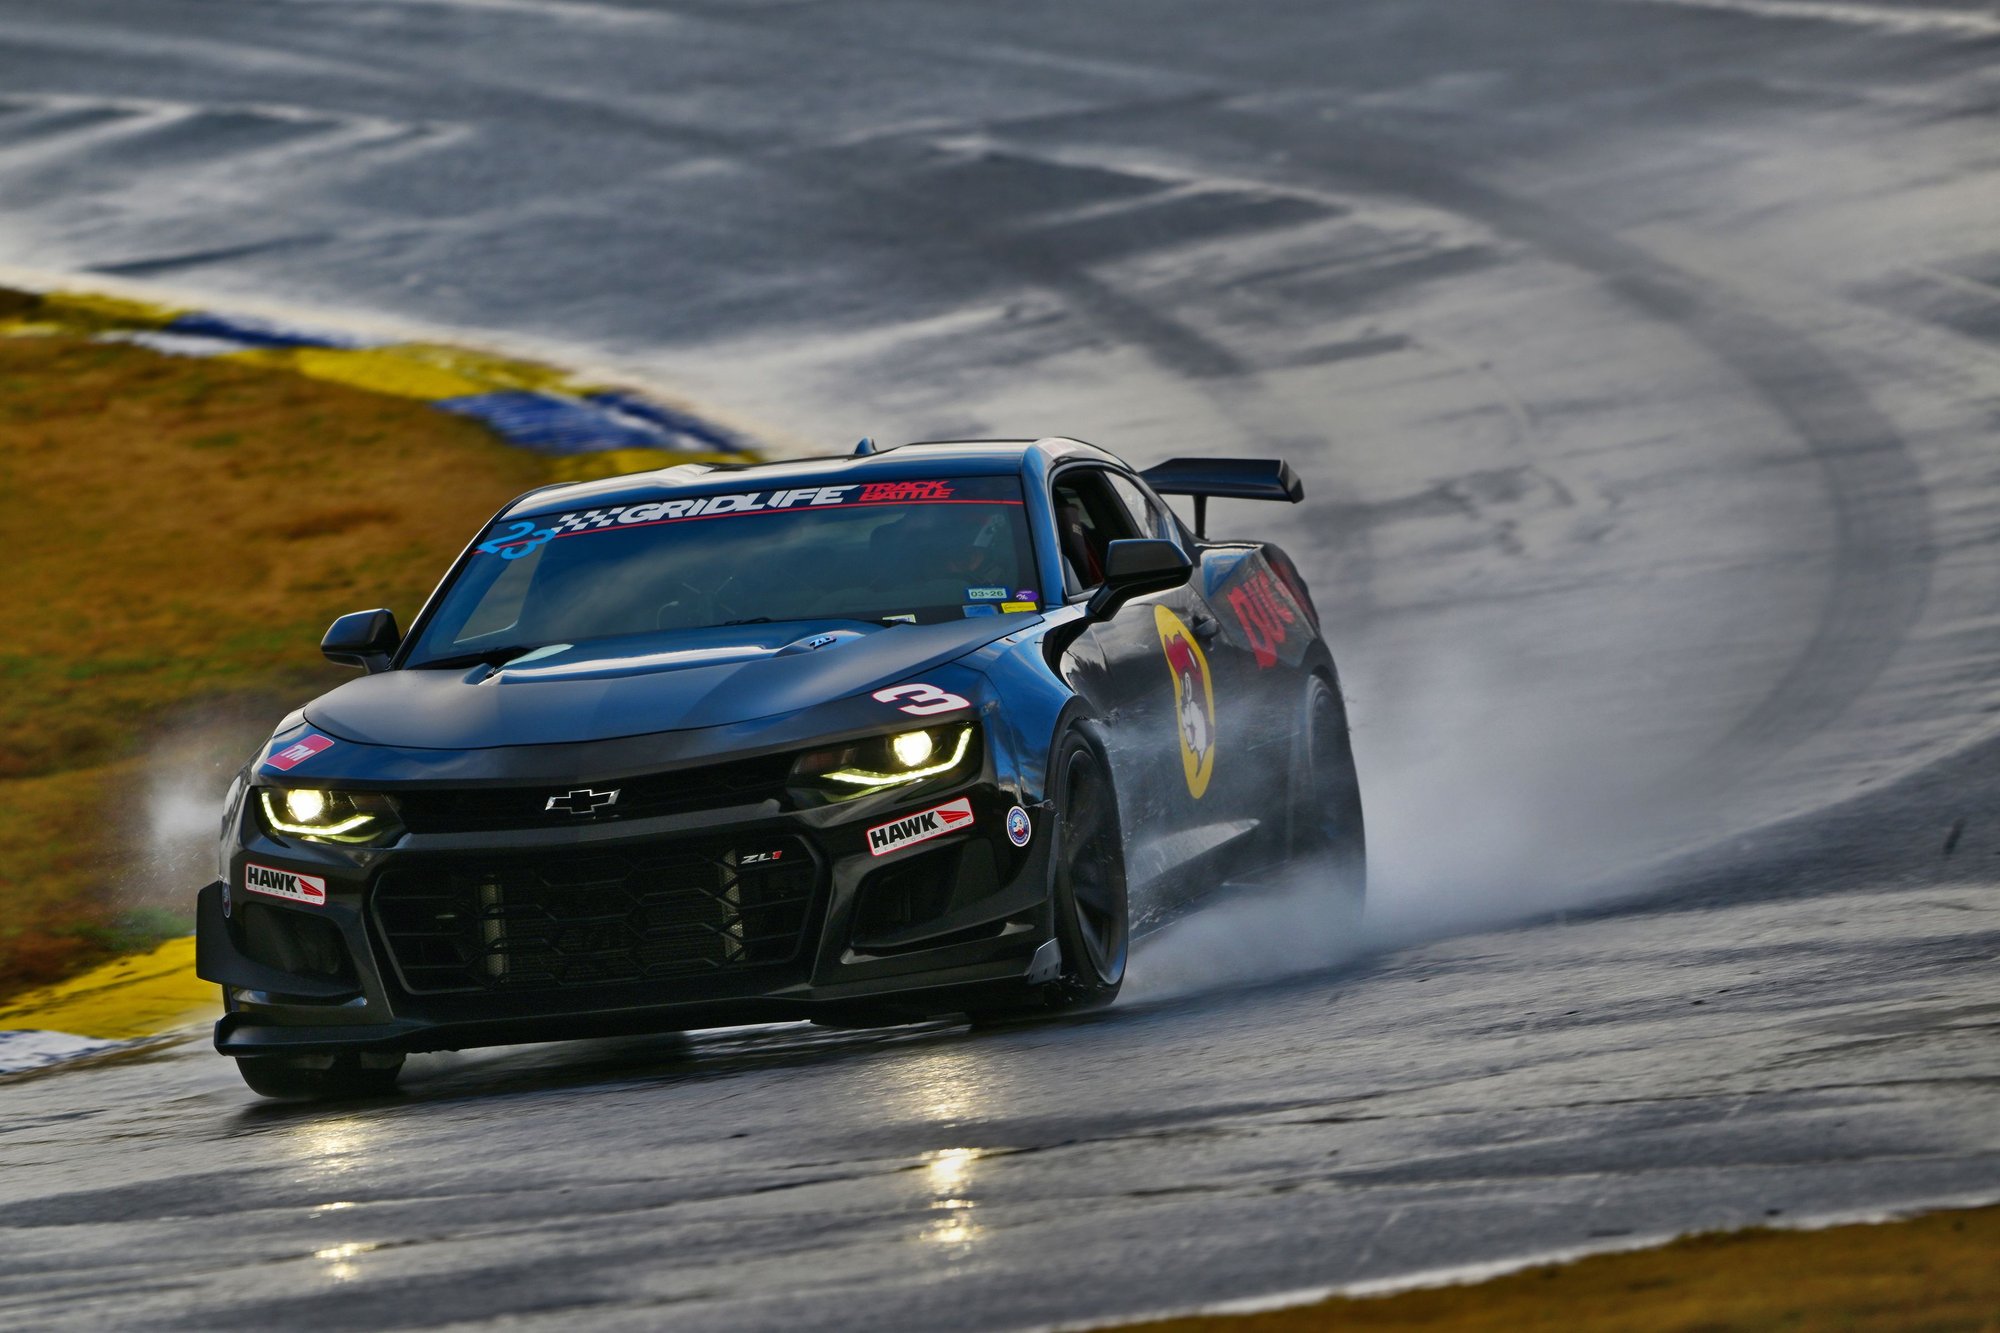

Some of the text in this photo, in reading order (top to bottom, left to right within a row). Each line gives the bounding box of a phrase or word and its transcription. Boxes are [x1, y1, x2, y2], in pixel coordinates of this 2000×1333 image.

[859, 489, 955, 501] BATTLE
[860, 481, 950, 493] TRACK
[617, 485, 860, 524] GRIDLIFE
[477, 521, 557, 560] 23
[872, 683, 972, 716] 3
[870, 811, 938, 849] HAWK
[740, 850, 782, 864] ZL1
[248, 866, 298, 893] HAWK
